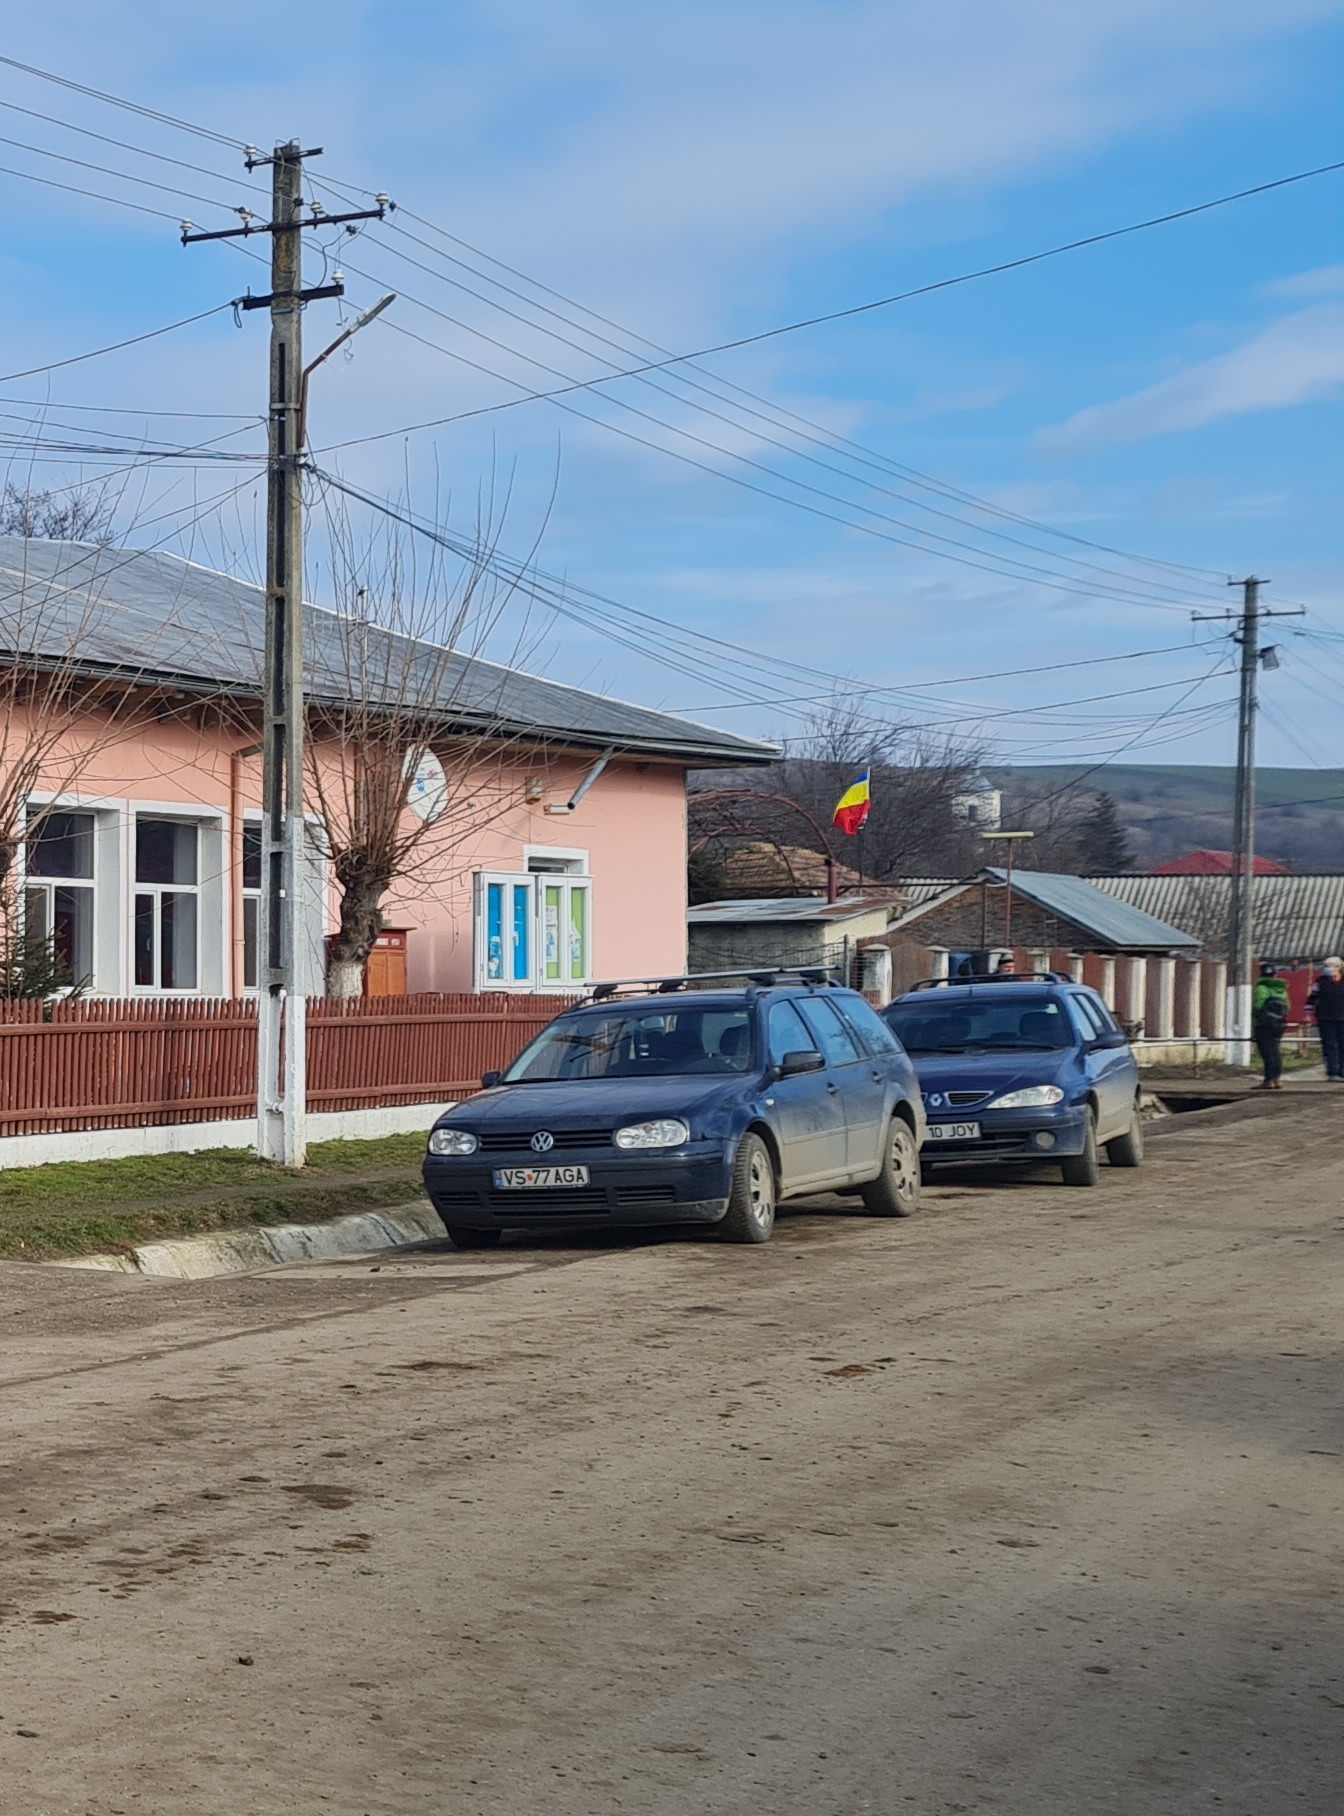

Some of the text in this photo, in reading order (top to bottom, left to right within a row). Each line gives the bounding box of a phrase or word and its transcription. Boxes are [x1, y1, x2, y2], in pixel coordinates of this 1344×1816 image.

[949, 1124, 976, 1138] JOY
[503, 1168, 585, 1186] VS 77 AGA
